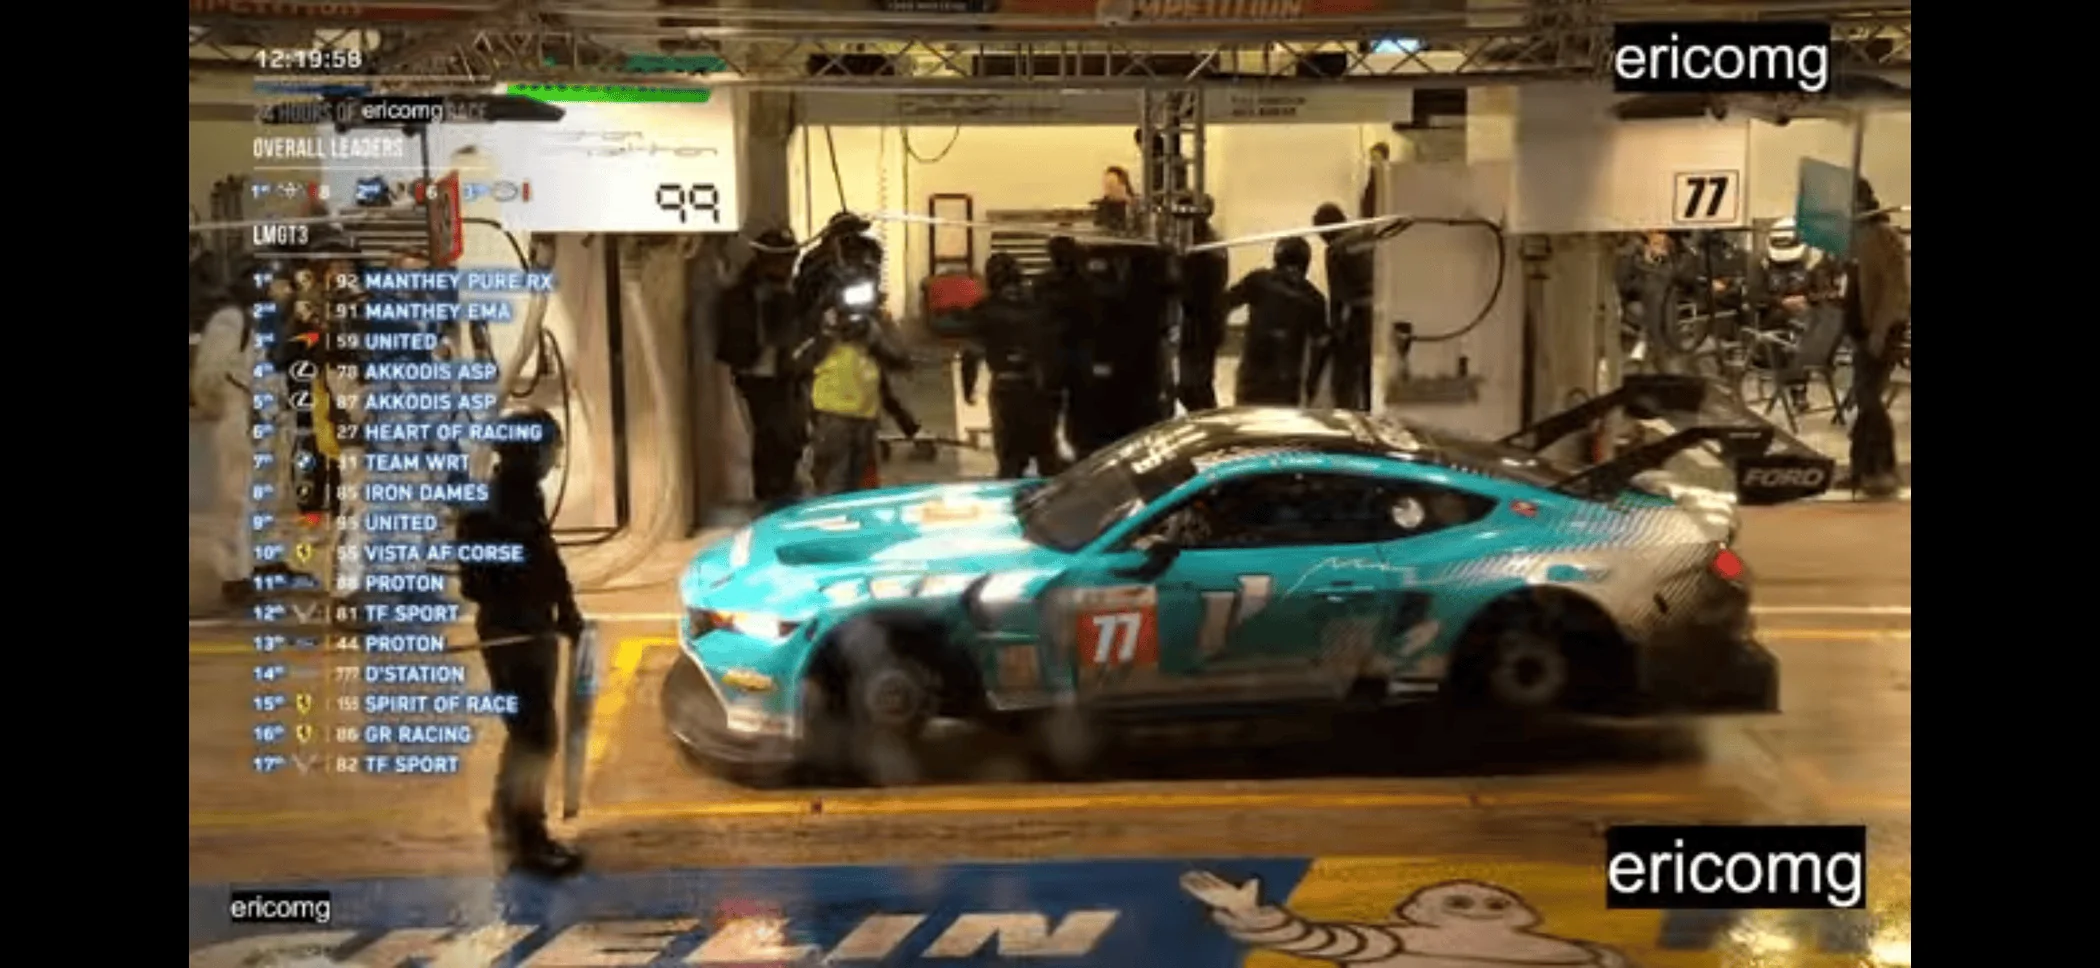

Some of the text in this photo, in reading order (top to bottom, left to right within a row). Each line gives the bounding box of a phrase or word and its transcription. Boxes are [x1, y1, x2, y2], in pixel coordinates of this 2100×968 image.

[655, 182, 720, 224] 99
[1683, 176, 1729, 219] 77
[1743, 466, 1825, 488] FORD
[1091, 612, 1143, 664] 77
